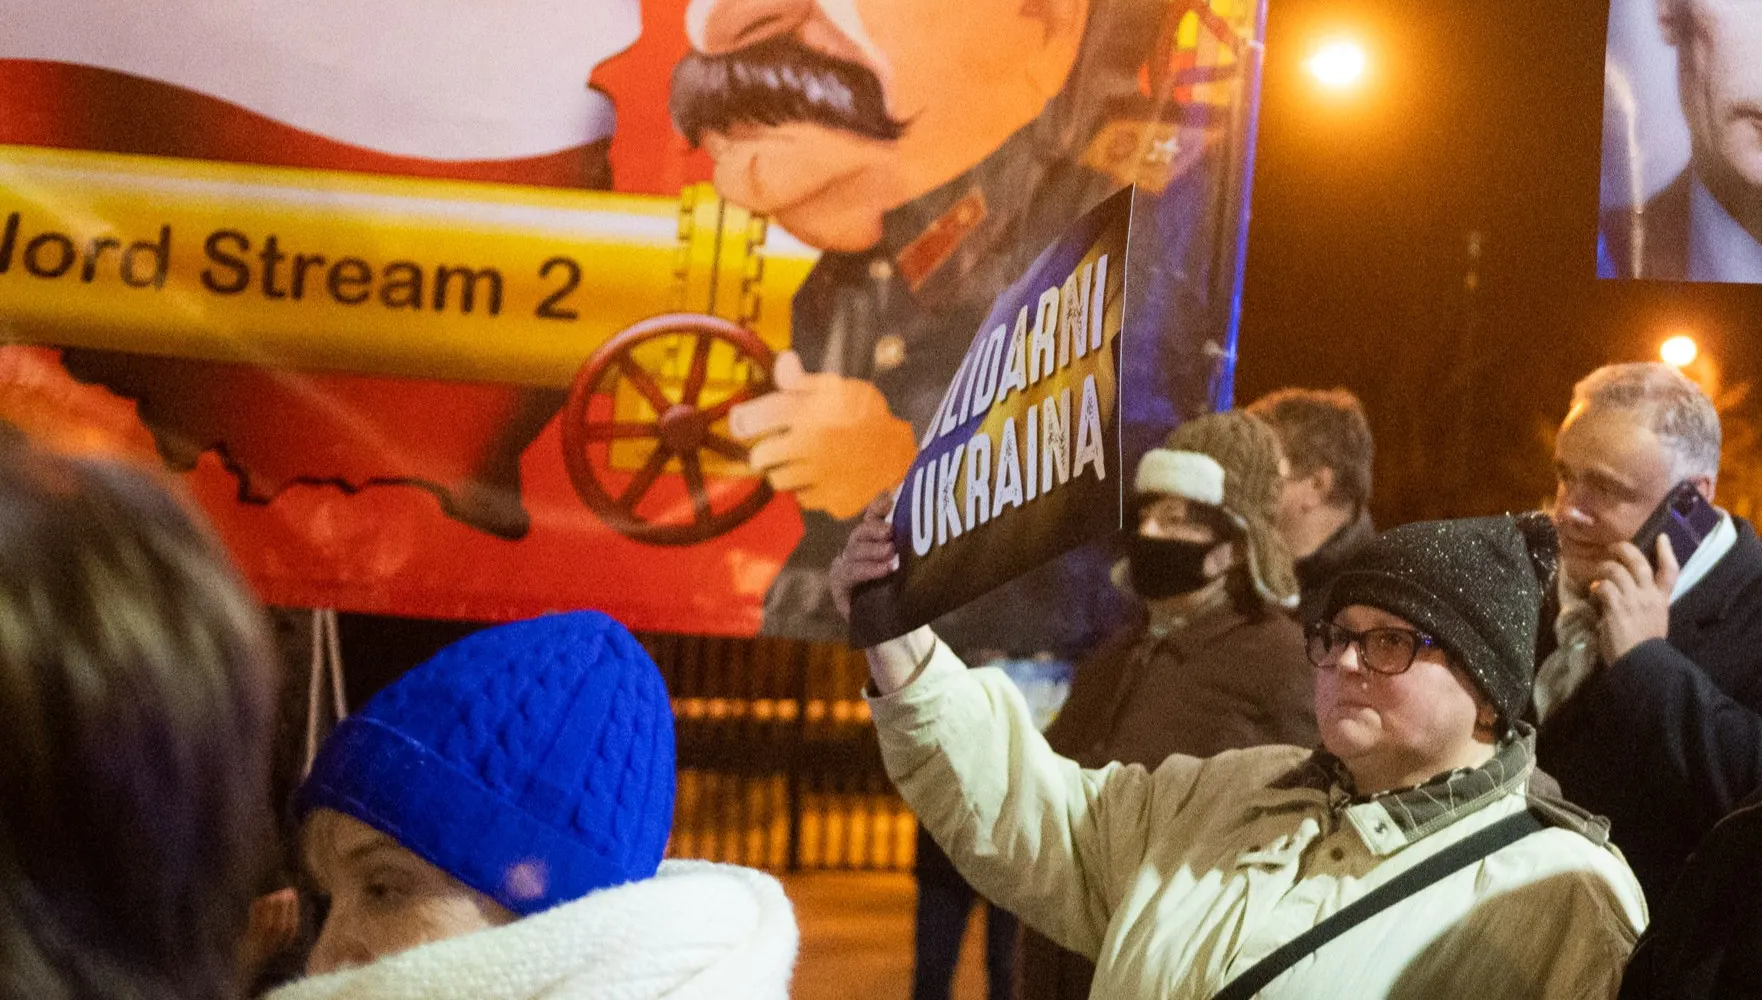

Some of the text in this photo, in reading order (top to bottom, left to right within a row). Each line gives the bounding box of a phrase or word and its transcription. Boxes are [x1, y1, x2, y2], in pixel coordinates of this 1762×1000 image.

[200, 228, 504, 317] Stream
[535, 256, 584, 321] 2
[911, 373, 1106, 557] UKRAINA
